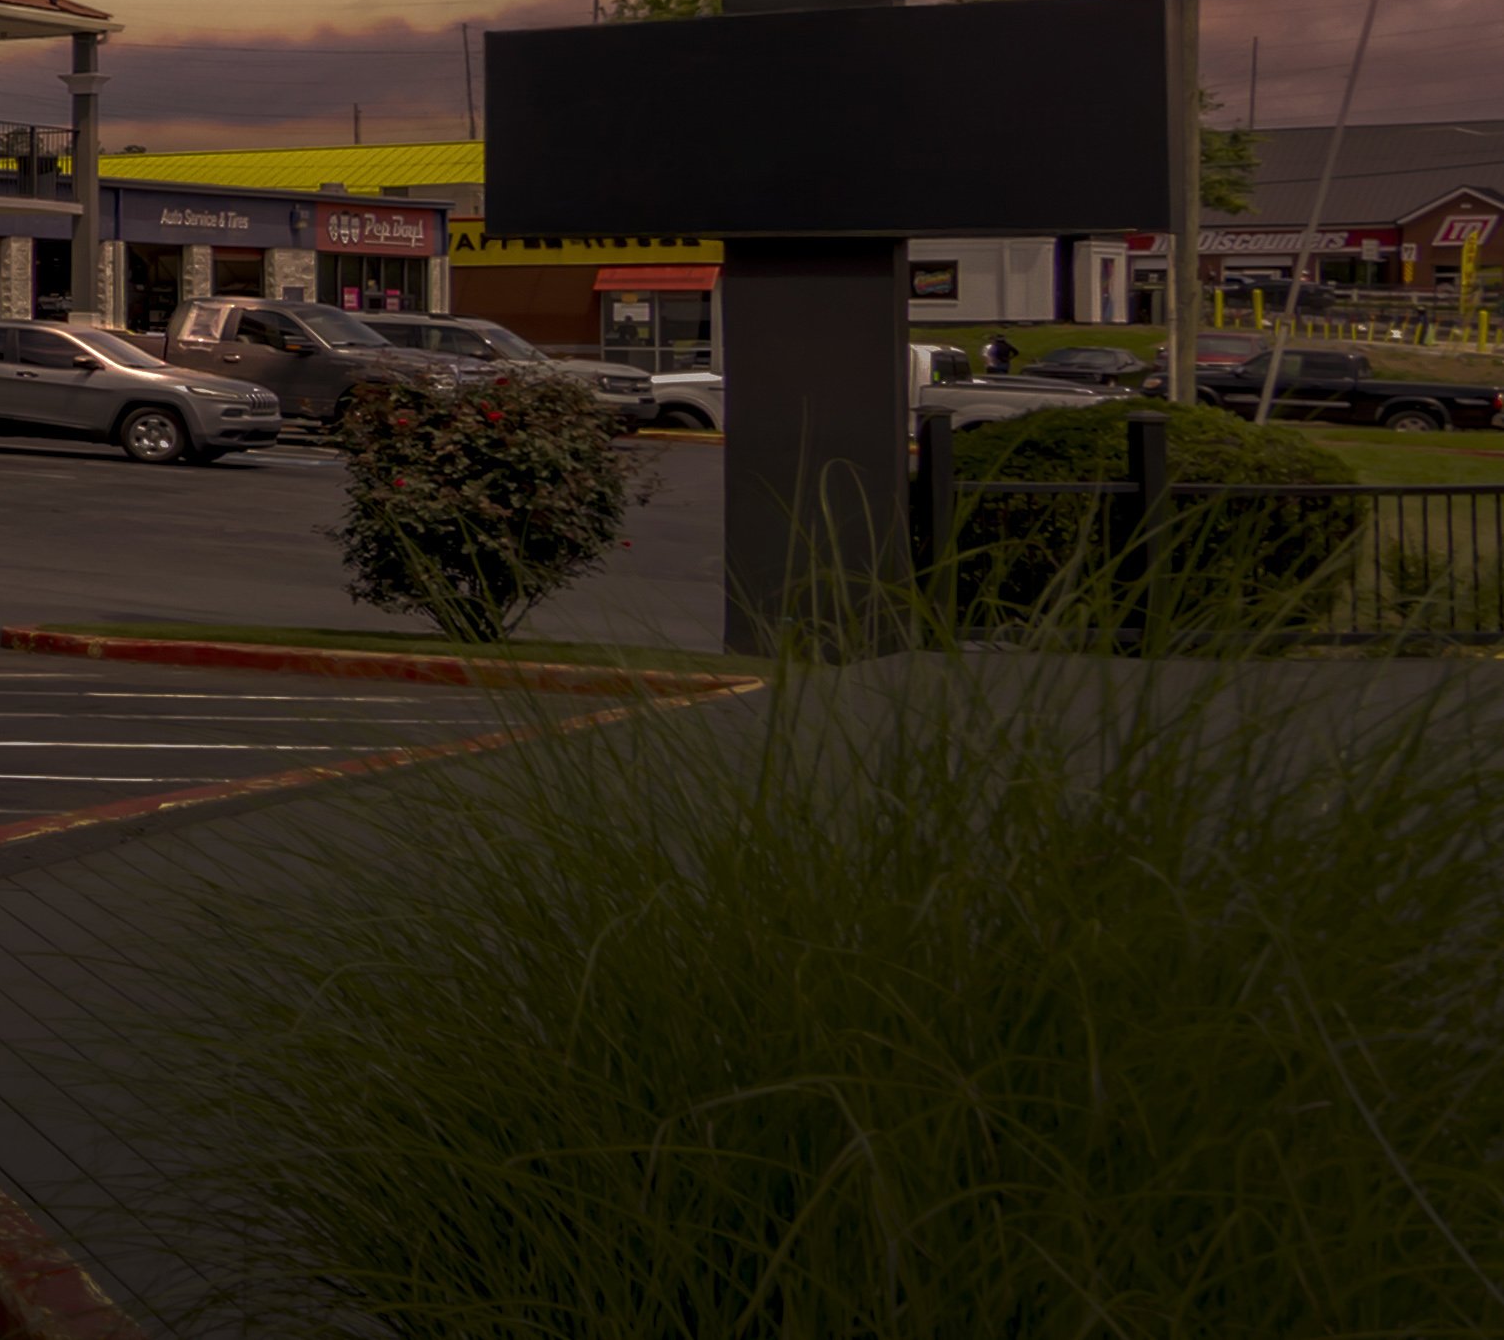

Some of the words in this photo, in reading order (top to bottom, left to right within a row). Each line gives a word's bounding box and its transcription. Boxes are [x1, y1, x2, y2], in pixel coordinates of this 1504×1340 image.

[160, 208, 183, 225] Auto
[184, 208, 217, 227] Service
[227, 211, 249, 229] Tires
[364, 213, 391, 242] Pep
[391, 215, 425, 248] Boys
